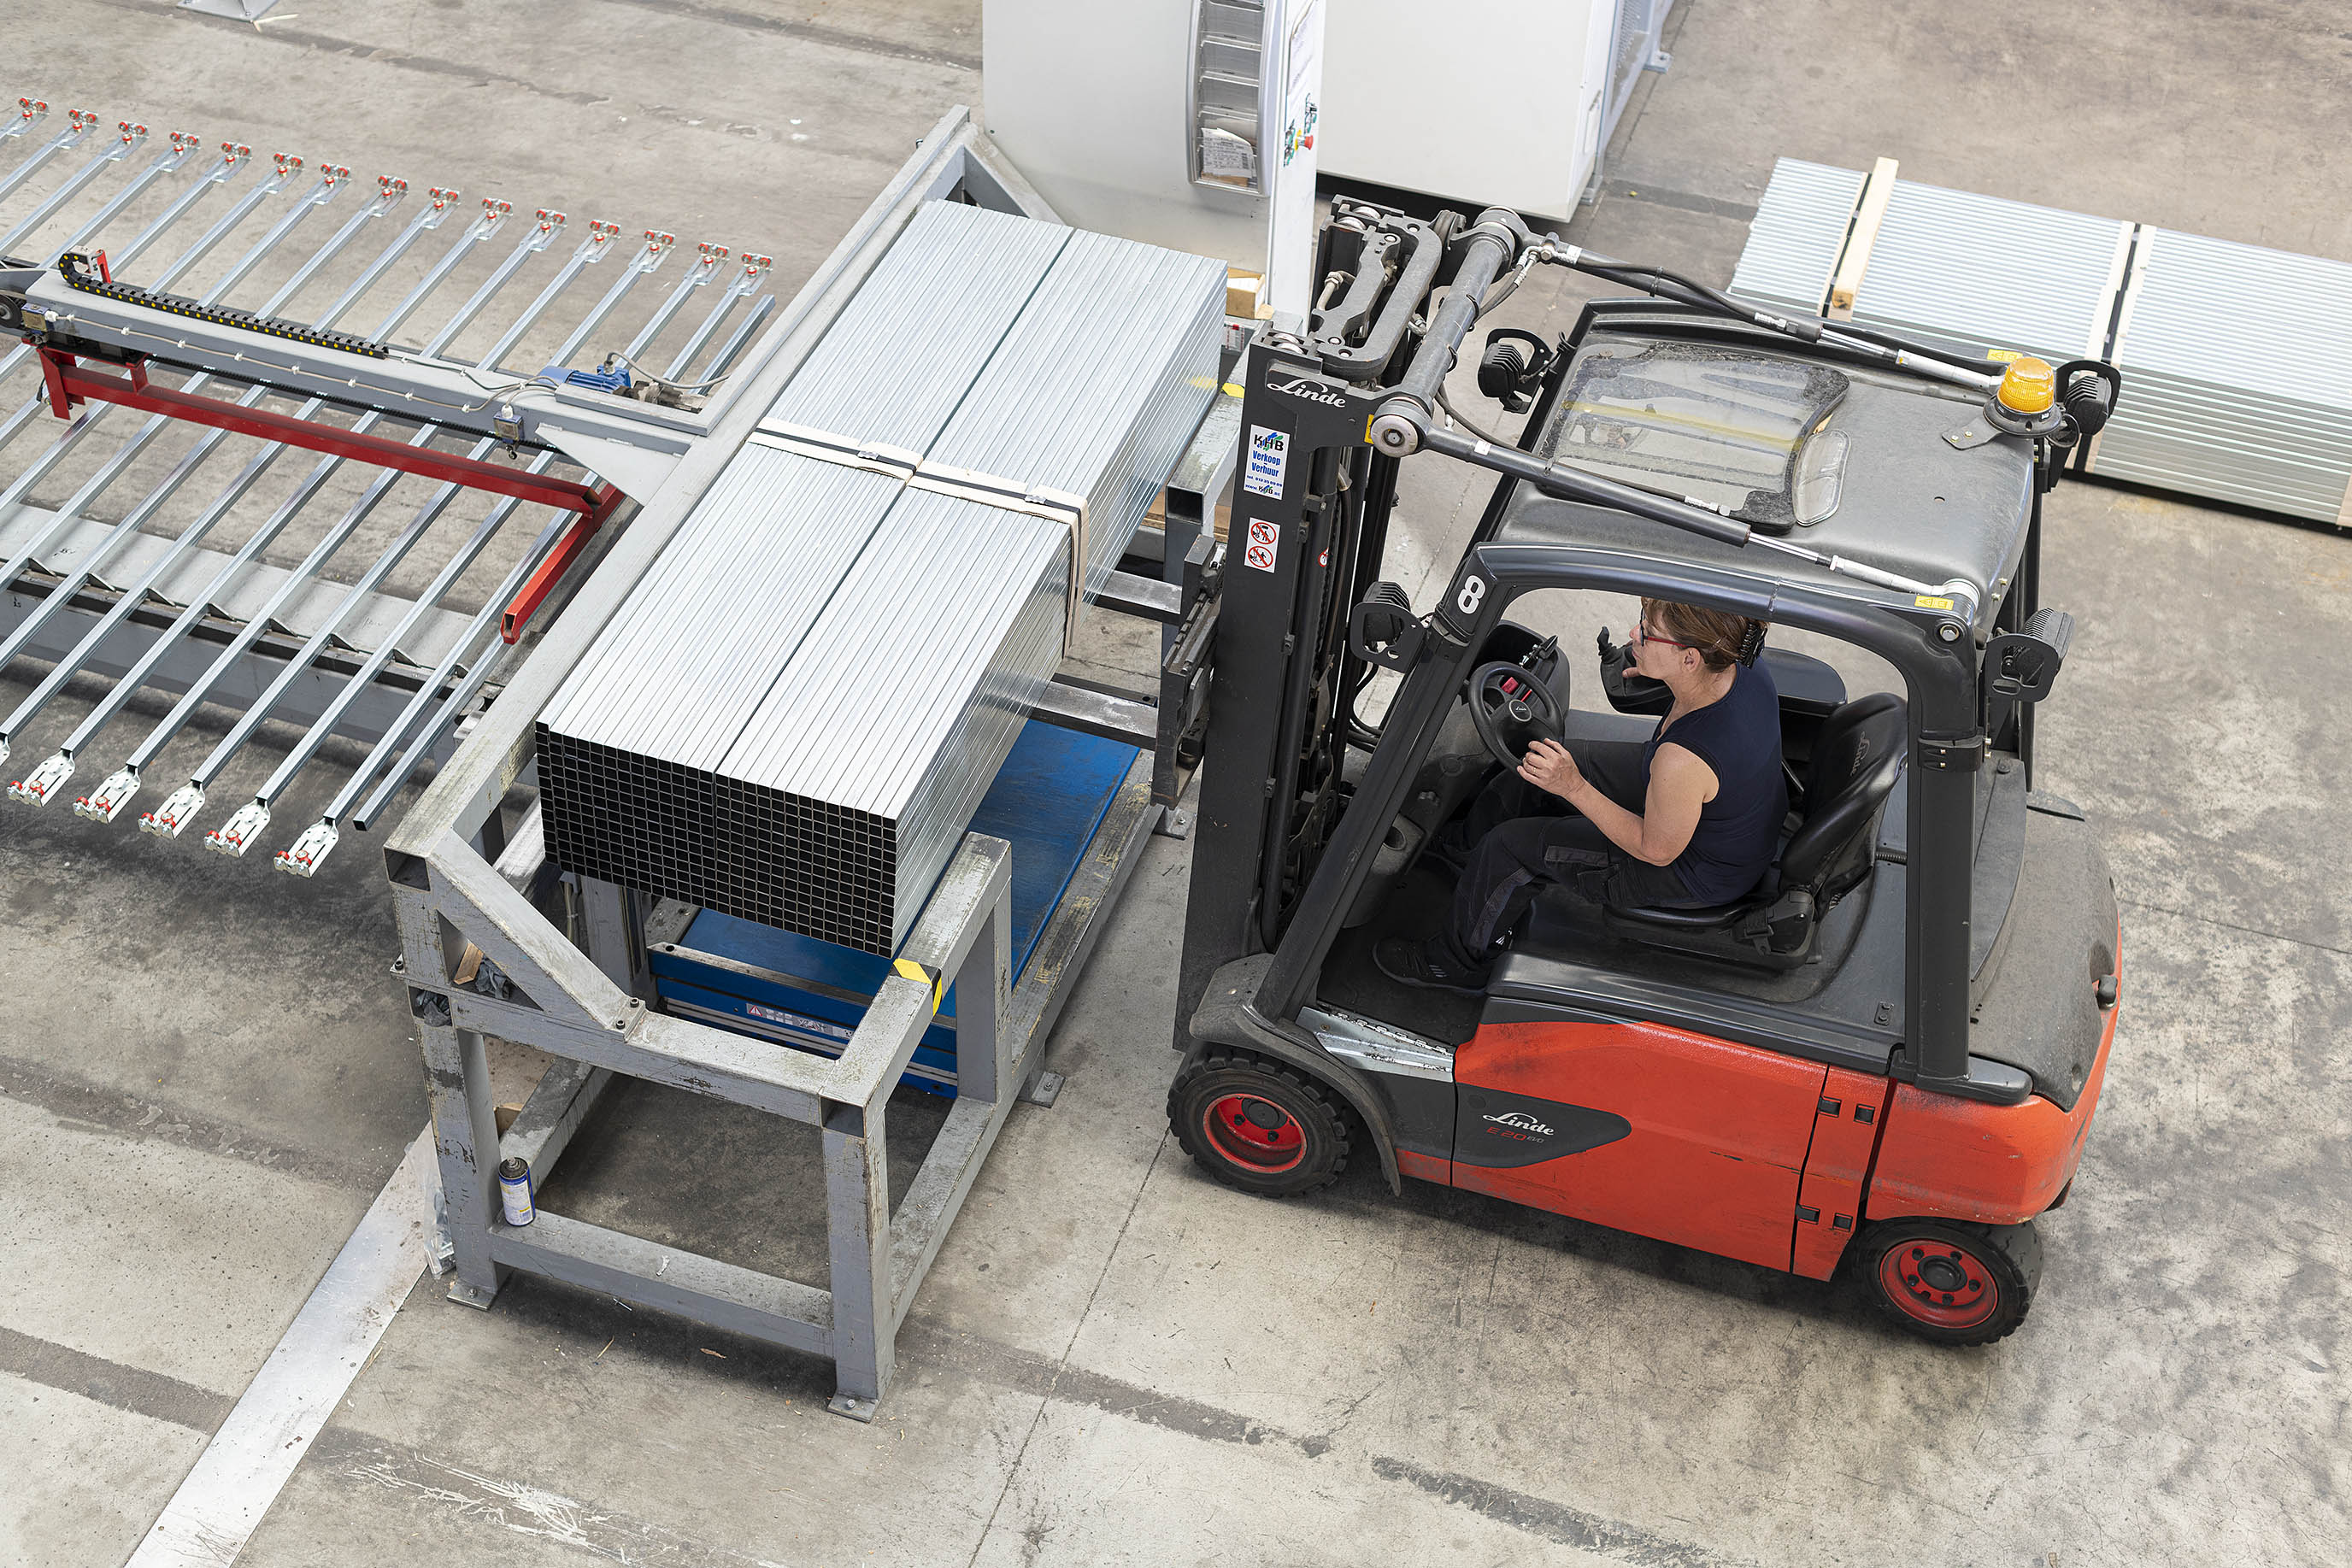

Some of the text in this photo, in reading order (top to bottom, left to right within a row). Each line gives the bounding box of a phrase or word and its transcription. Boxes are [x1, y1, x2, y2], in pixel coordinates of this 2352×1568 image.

[1267, 379, 1346, 408] Linde
[1254, 434, 1284, 451] KHB
[1253, 450, 1280, 466] Verkoop
[1251, 462, 1279, 477] Verhuur
[1457, 574, 1486, 614] 8
[1849, 731, 1870, 776] Linde
[1483, 1113, 1554, 1135] Linde
